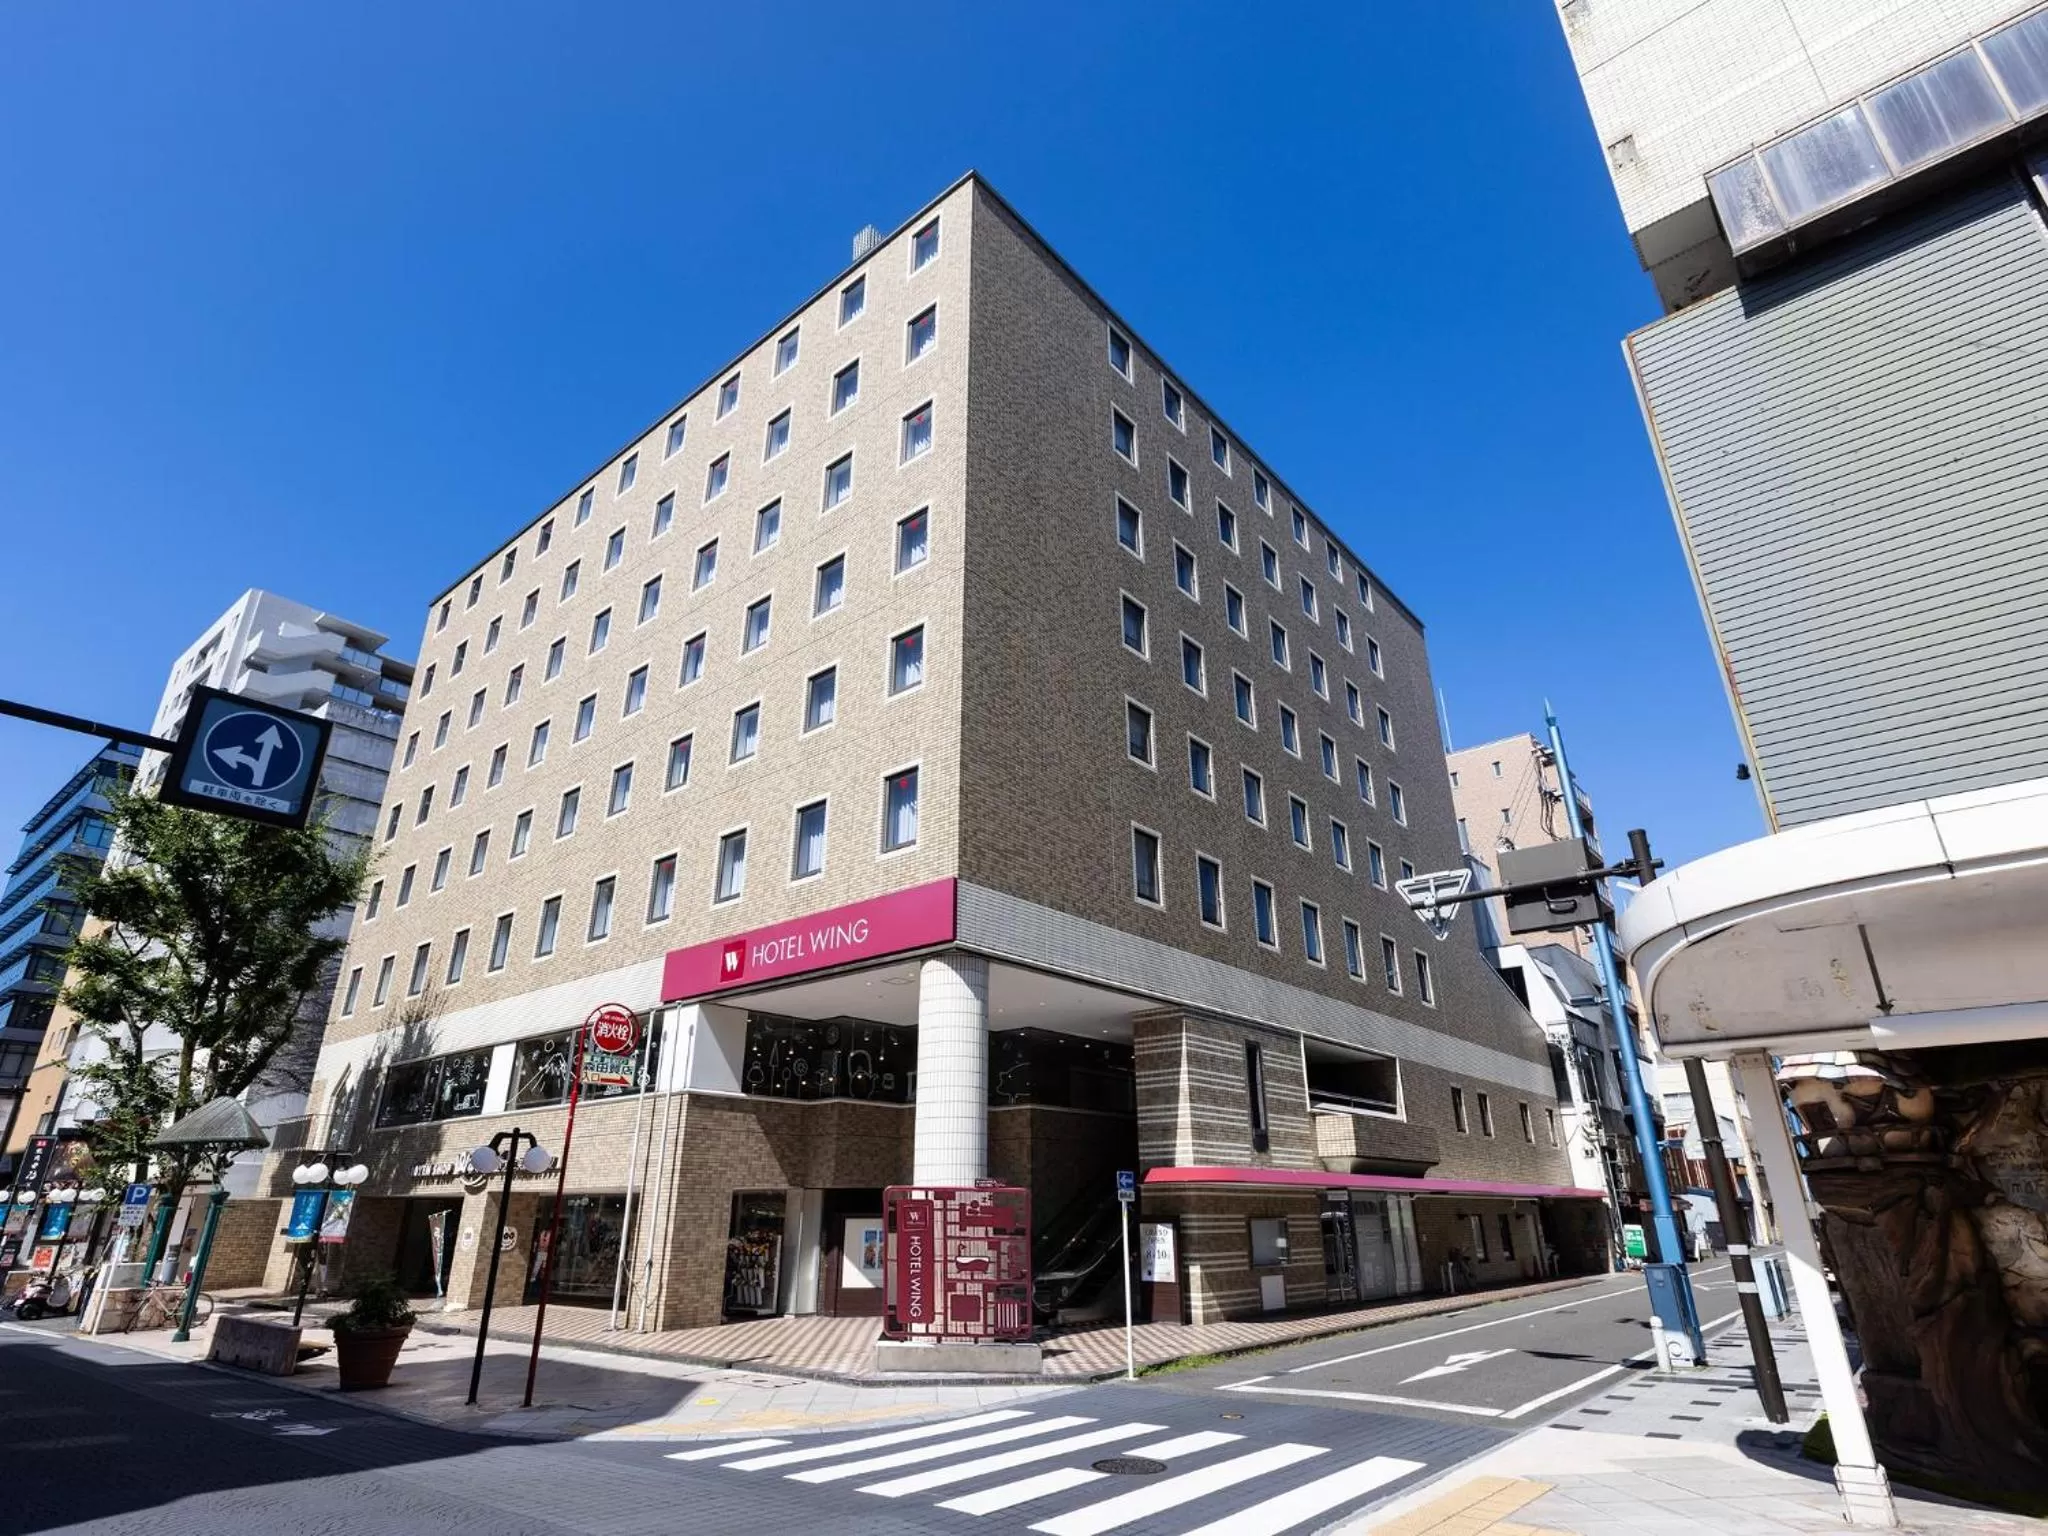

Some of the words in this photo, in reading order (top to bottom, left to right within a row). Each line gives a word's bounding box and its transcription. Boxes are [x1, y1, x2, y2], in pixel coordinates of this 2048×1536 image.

[752, 935, 804, 968] HOTEL
[809, 918, 869, 953] WING
[596, 1021, 629, 1040] 消火栓
[582, 1072, 600, 1082] 入口
[131, 1187, 147, 1203] P
[910, 1236, 922, 1274] HOTEL
[910, 1275, 922, 1317] WING
